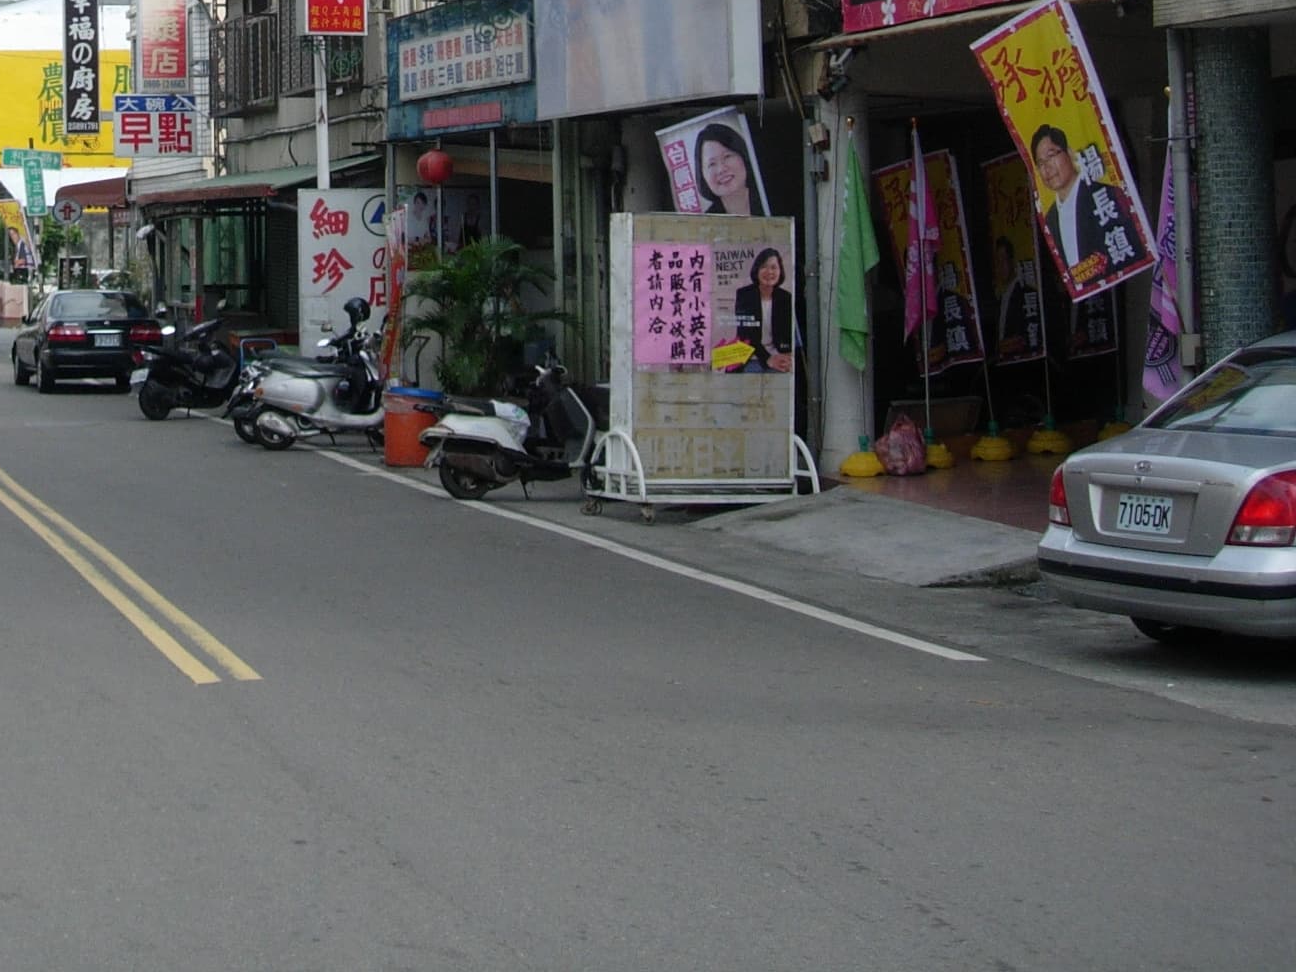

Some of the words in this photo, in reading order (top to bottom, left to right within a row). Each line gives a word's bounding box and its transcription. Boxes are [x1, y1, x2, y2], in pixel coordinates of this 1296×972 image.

[119, 113, 193, 154] 早點
[309, 197, 354, 295] 細珍
[1077, 145, 1137, 265] 楊長鎮
